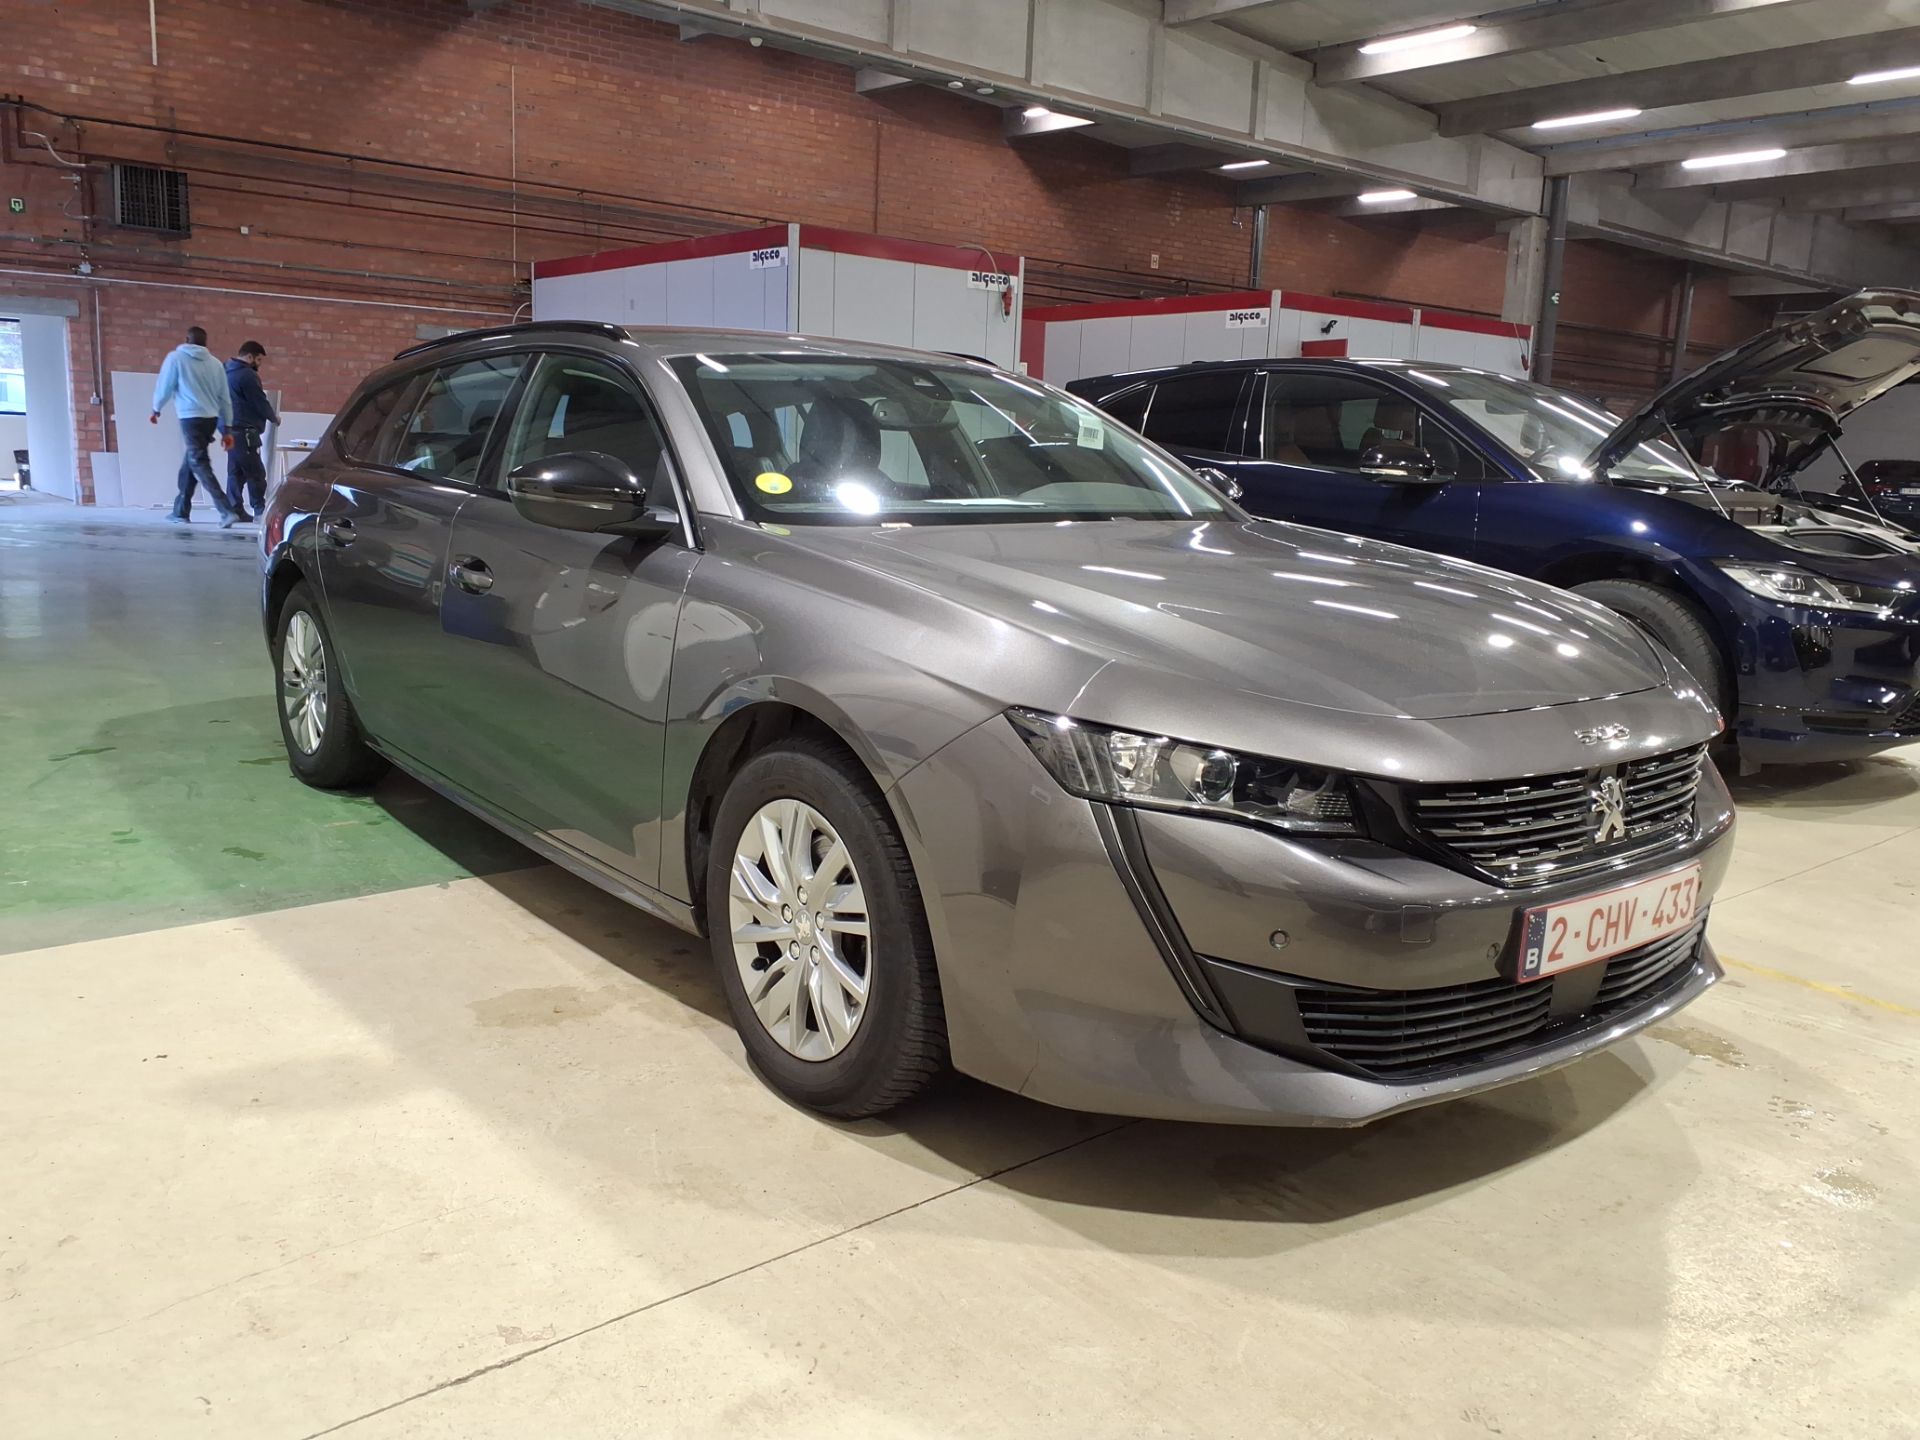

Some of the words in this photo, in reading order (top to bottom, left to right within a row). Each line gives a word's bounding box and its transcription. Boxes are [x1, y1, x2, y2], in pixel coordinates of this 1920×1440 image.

[752, 249, 780, 266] algeco
[1229, 312, 1261, 325] algeco
[1525, 947, 1540, 970] B
[1546, 877, 1695, 963] 2-CHV-433
